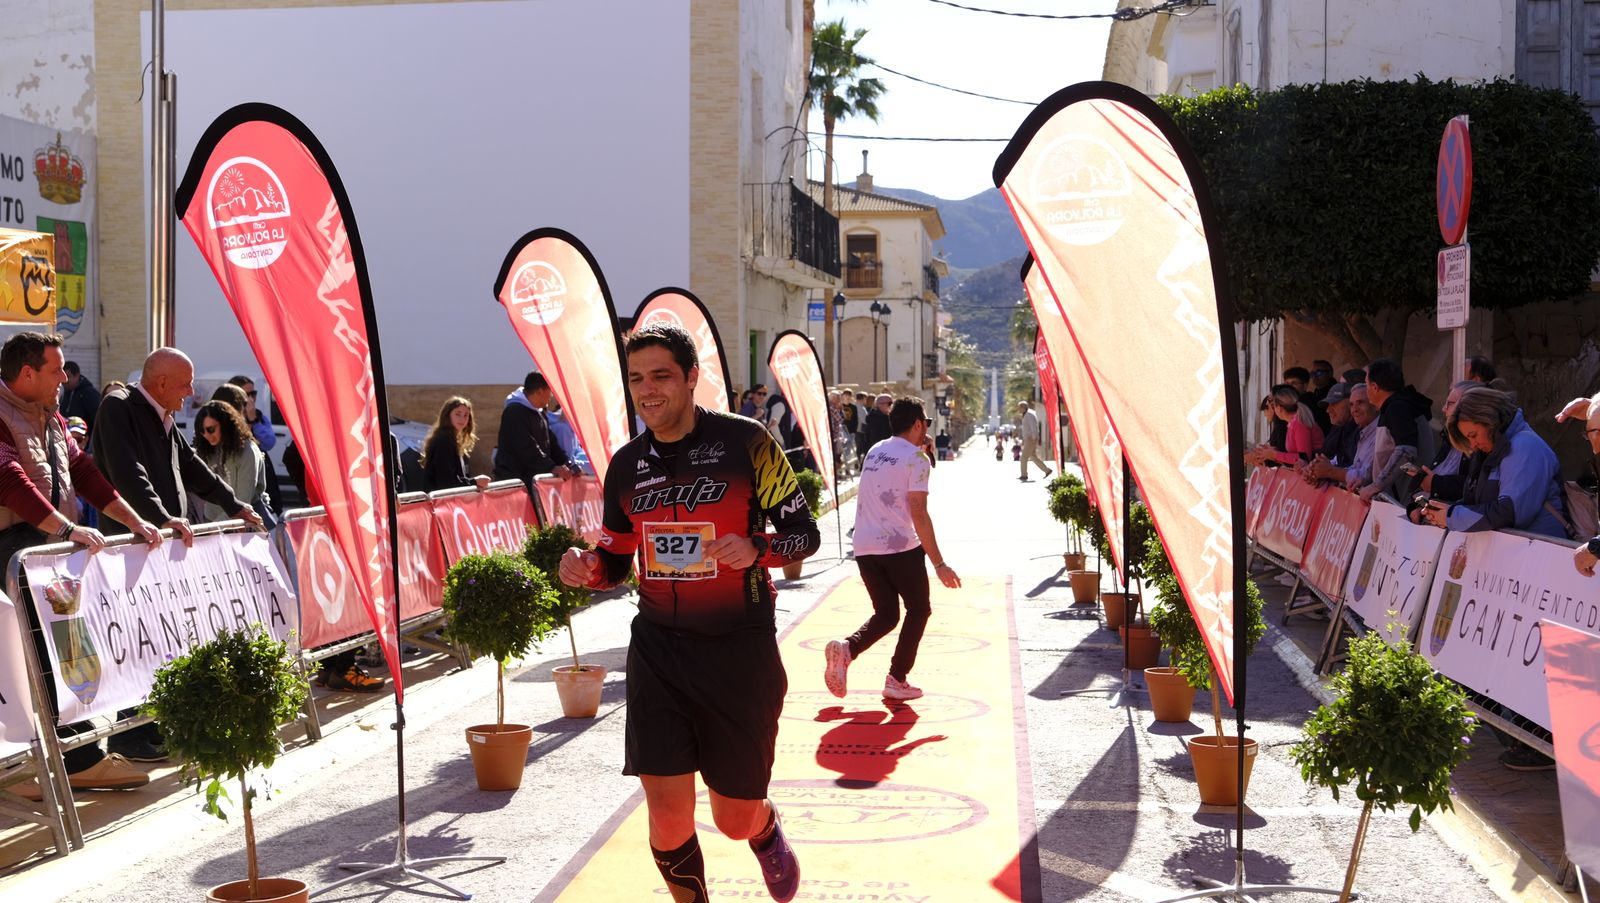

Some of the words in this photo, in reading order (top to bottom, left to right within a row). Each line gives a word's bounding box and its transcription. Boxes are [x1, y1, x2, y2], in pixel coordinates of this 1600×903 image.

[655, 536, 699, 554] 327
[99, 570, 246, 612] AYUNTAMIENTO
[251, 565, 275, 586] DE
[107, 591, 287, 665] CANTORIA
[1460, 599, 1543, 667] CANTO
[1587, 605, 1600, 631] D
[768, 791, 890, 802] POLVO
